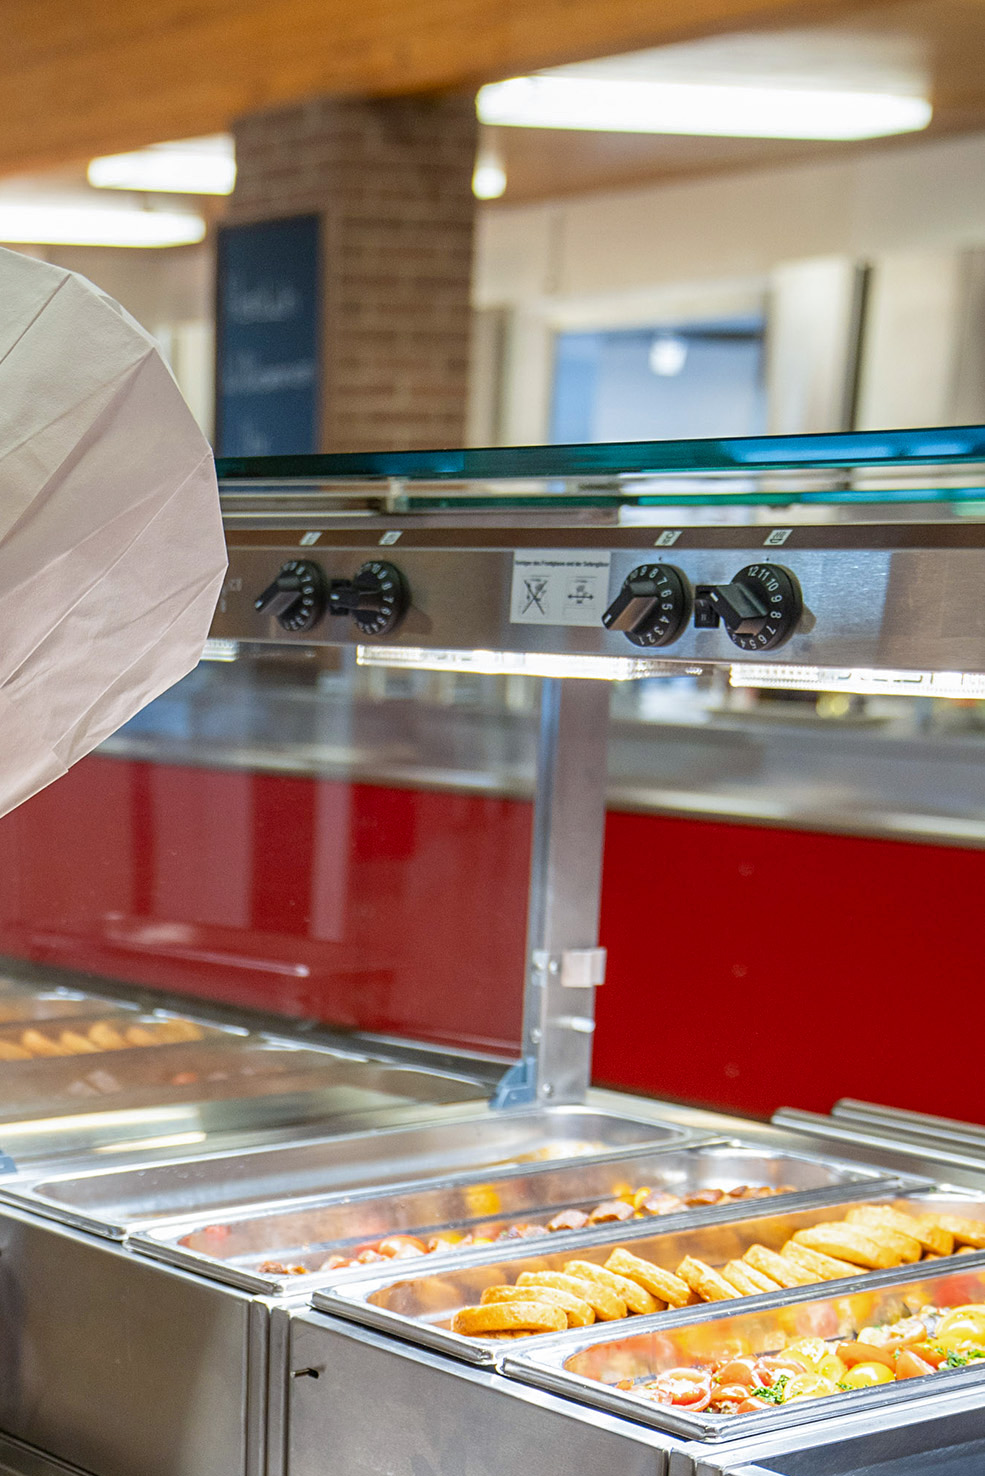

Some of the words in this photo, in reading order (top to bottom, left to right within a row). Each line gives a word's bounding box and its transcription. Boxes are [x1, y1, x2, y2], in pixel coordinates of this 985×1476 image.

[747, 566, 760, 577] 12
[758, 569, 771, 581] 11
[657, 576, 668, 586] 7
[766, 578, 779, 592] 10
[661, 589, 672, 598] 6
[770, 594, 783, 603] 9
[661, 603, 673, 611] 5
[659, 615, 670, 624] 4
[770, 610, 782, 619] 8
[653, 626, 664, 636] 3
[766, 625, 776, 635] 7
[646, 633, 656, 643] 2
[758, 634, 768, 645] 6
